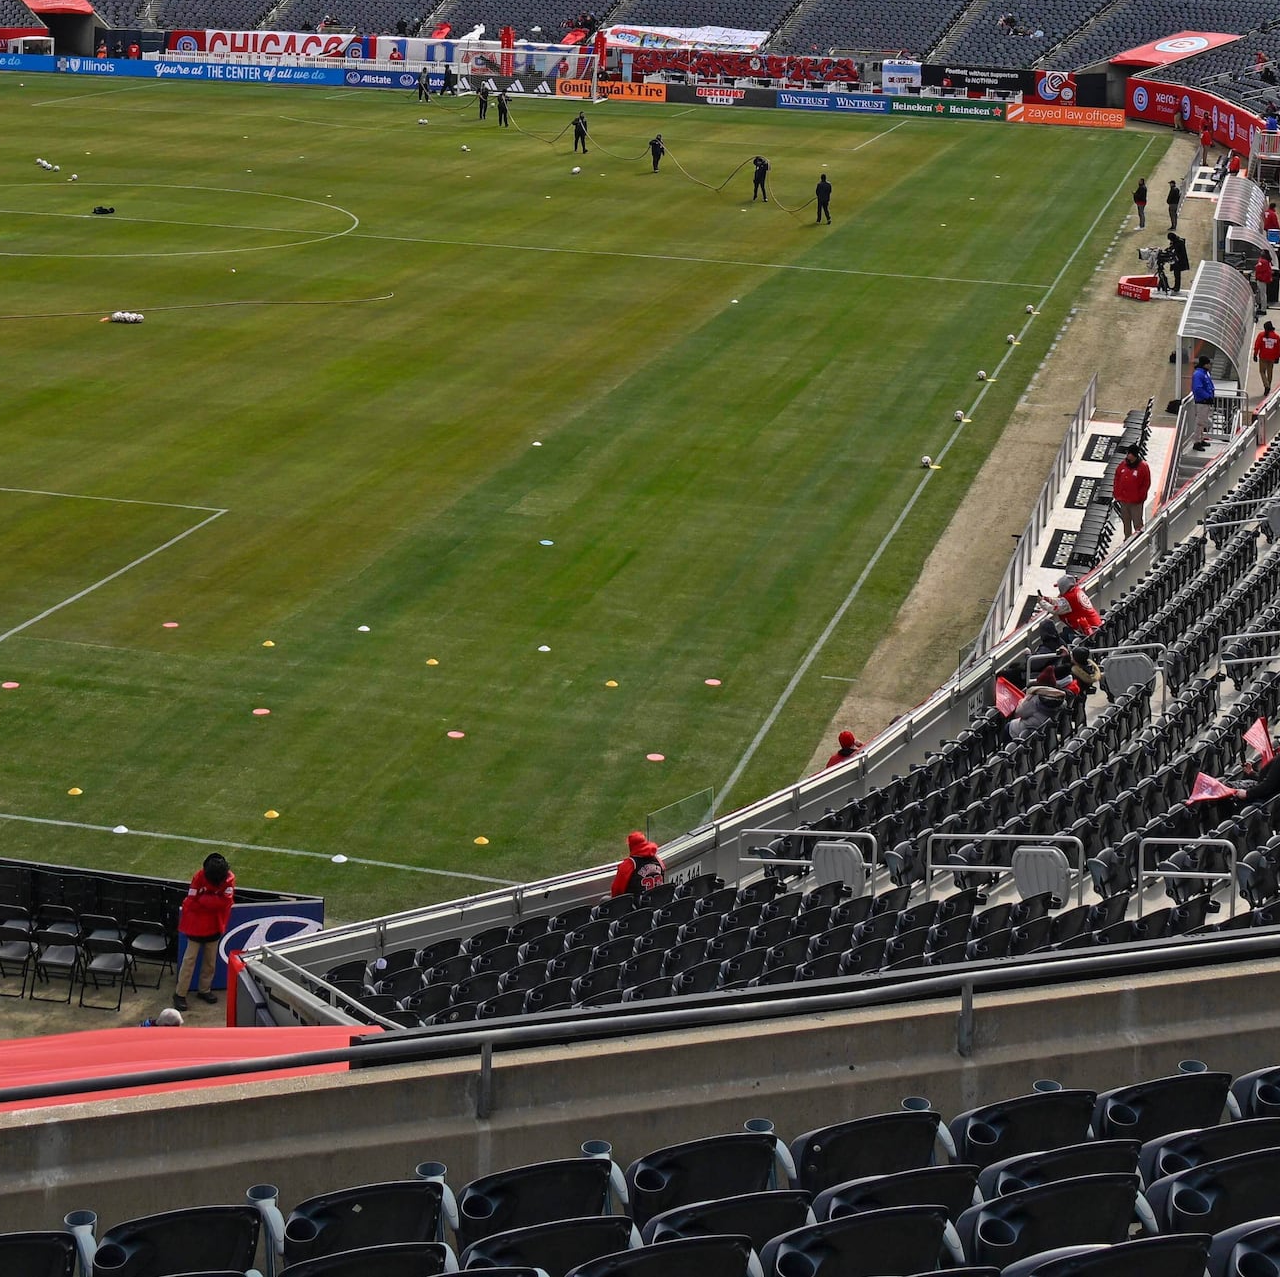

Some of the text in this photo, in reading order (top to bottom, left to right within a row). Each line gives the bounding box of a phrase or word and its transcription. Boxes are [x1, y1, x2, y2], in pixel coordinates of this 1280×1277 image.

[7, 56, 21, 66] do
[82, 60, 114, 72] Illinois
[154, 64, 326, 81] You're at THE CENTER of all we do
[361, 75, 392, 84] Allstate
[637, 84, 663, 97] Tire
[696, 87, 746, 99] DISCOUNT
[780, 94, 829, 105] WINTRUST
[836, 98, 885, 109] WINTRUST
[892, 101, 933, 113] Heineken
[949, 105, 990, 117] Heineken
[1028, 107, 1122, 122] zayed law offices
